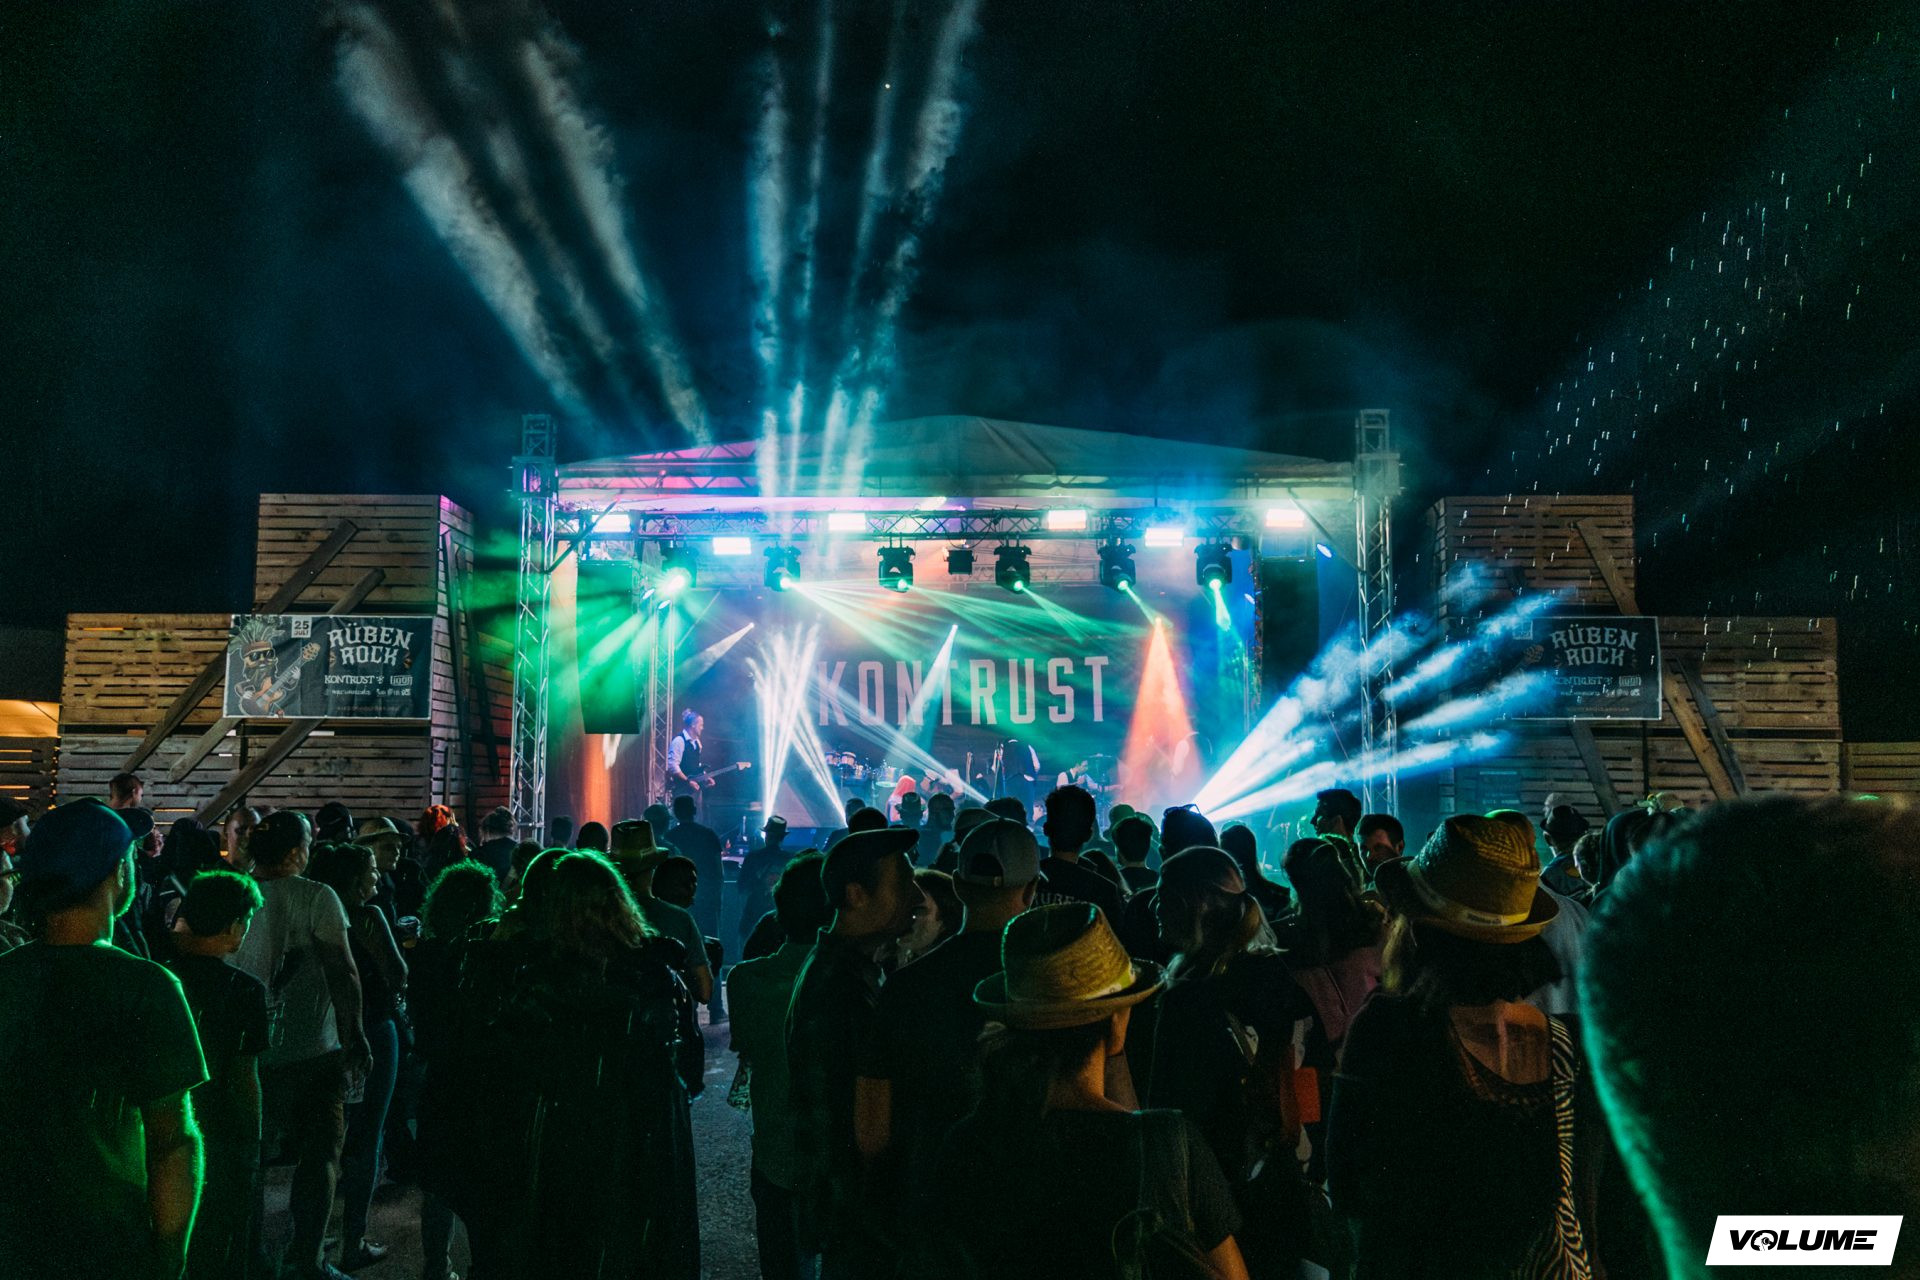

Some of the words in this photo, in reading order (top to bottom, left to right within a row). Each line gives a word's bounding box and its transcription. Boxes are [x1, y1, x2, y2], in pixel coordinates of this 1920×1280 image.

[294, 620, 310, 630] 25
[327, 622, 414, 650] RÜBEN
[1549, 624, 1639, 650] RÜBEN
[339, 645, 399, 666] ROCK
[1565, 646, 1625, 667] ROCK
[324, 675, 375, 684] KONTRUST
[1553, 676, 1603, 685] ONTRUST
[818, 656, 1109, 727] KONTRUST
